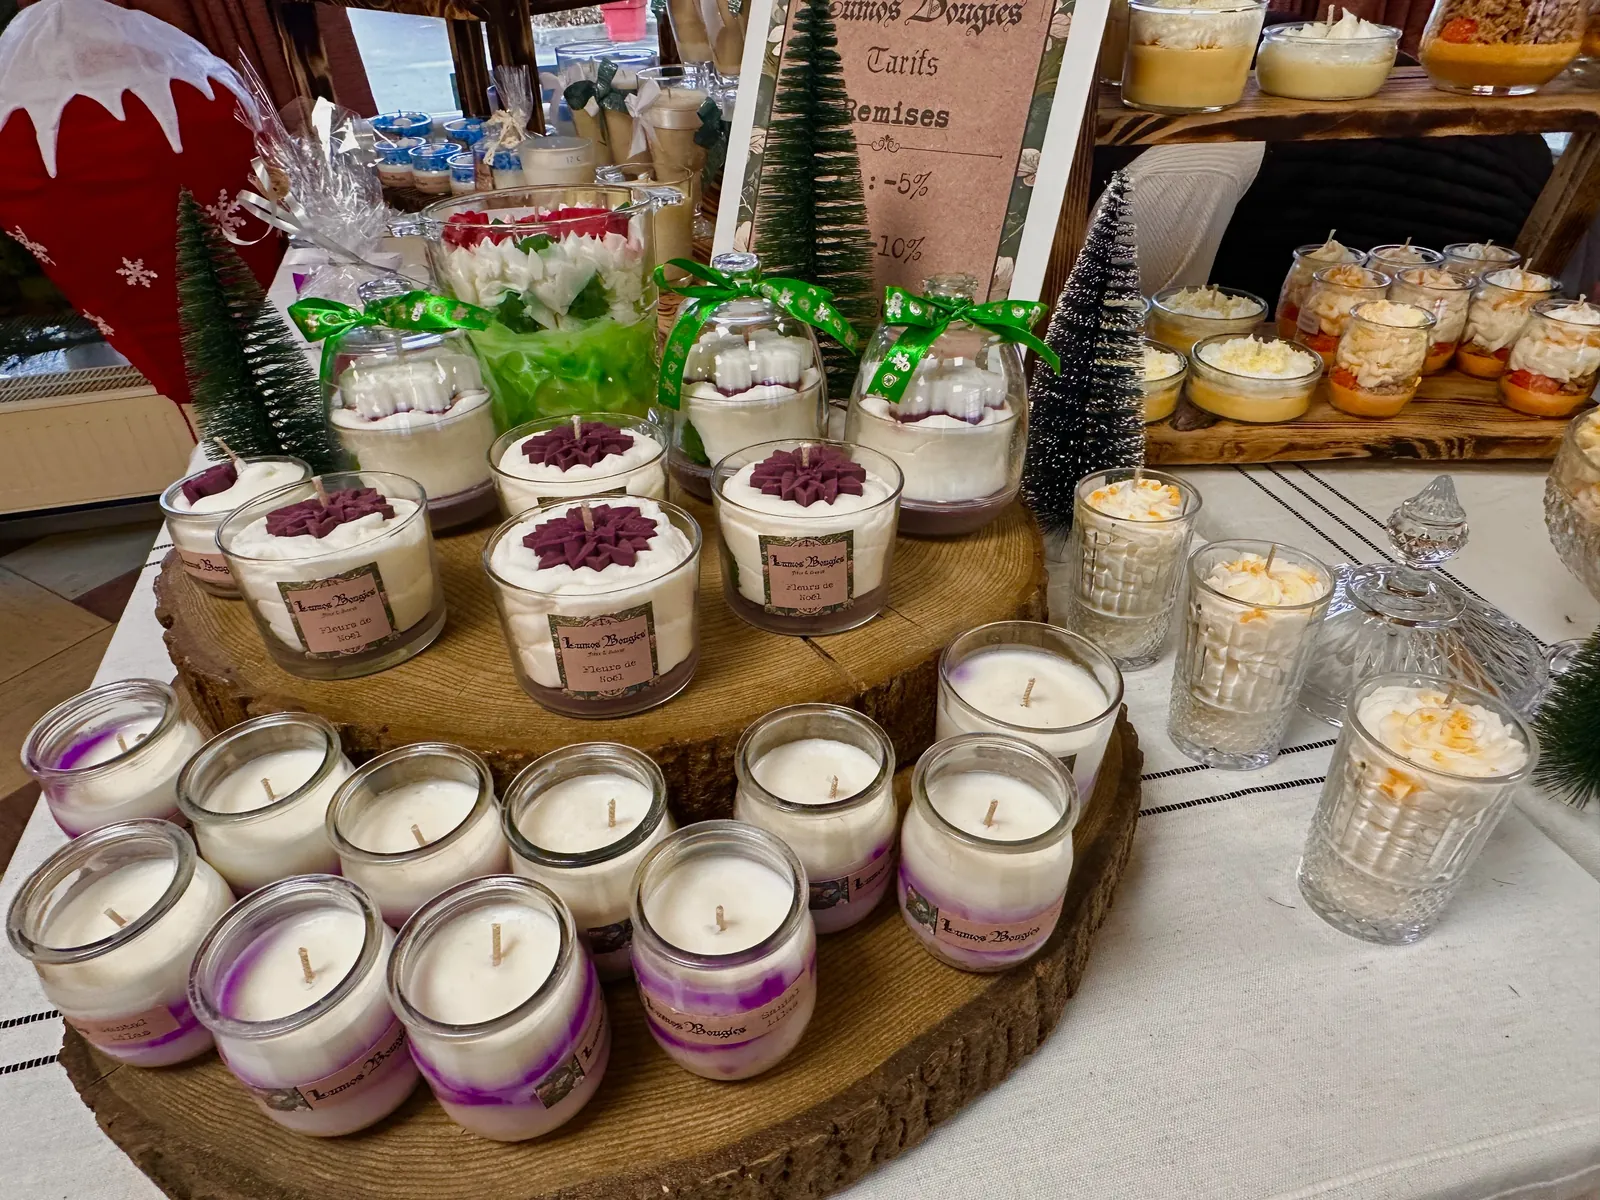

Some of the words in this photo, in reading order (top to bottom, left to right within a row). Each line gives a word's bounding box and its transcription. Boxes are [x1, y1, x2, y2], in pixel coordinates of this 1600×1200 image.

[867, 46, 939, 76] Tarifs
[845, 98, 950, 128] Remises
[884, 171, 932, 199] -5%
[770, 554, 805, 567] Lumos
[805, 555, 845, 568] Bougies
[294, 600, 333, 613] Lumos
[332, 587, 376, 607] Bougies
[561, 636, 601, 651] Lumos
[601, 629, 646, 649] Bougies
[624, 660, 637, 668] de
[940, 917, 987, 943] Lumos
[683, 1021, 747, 1039] Bougies
[305, 1073, 365, 1101] Lumos
